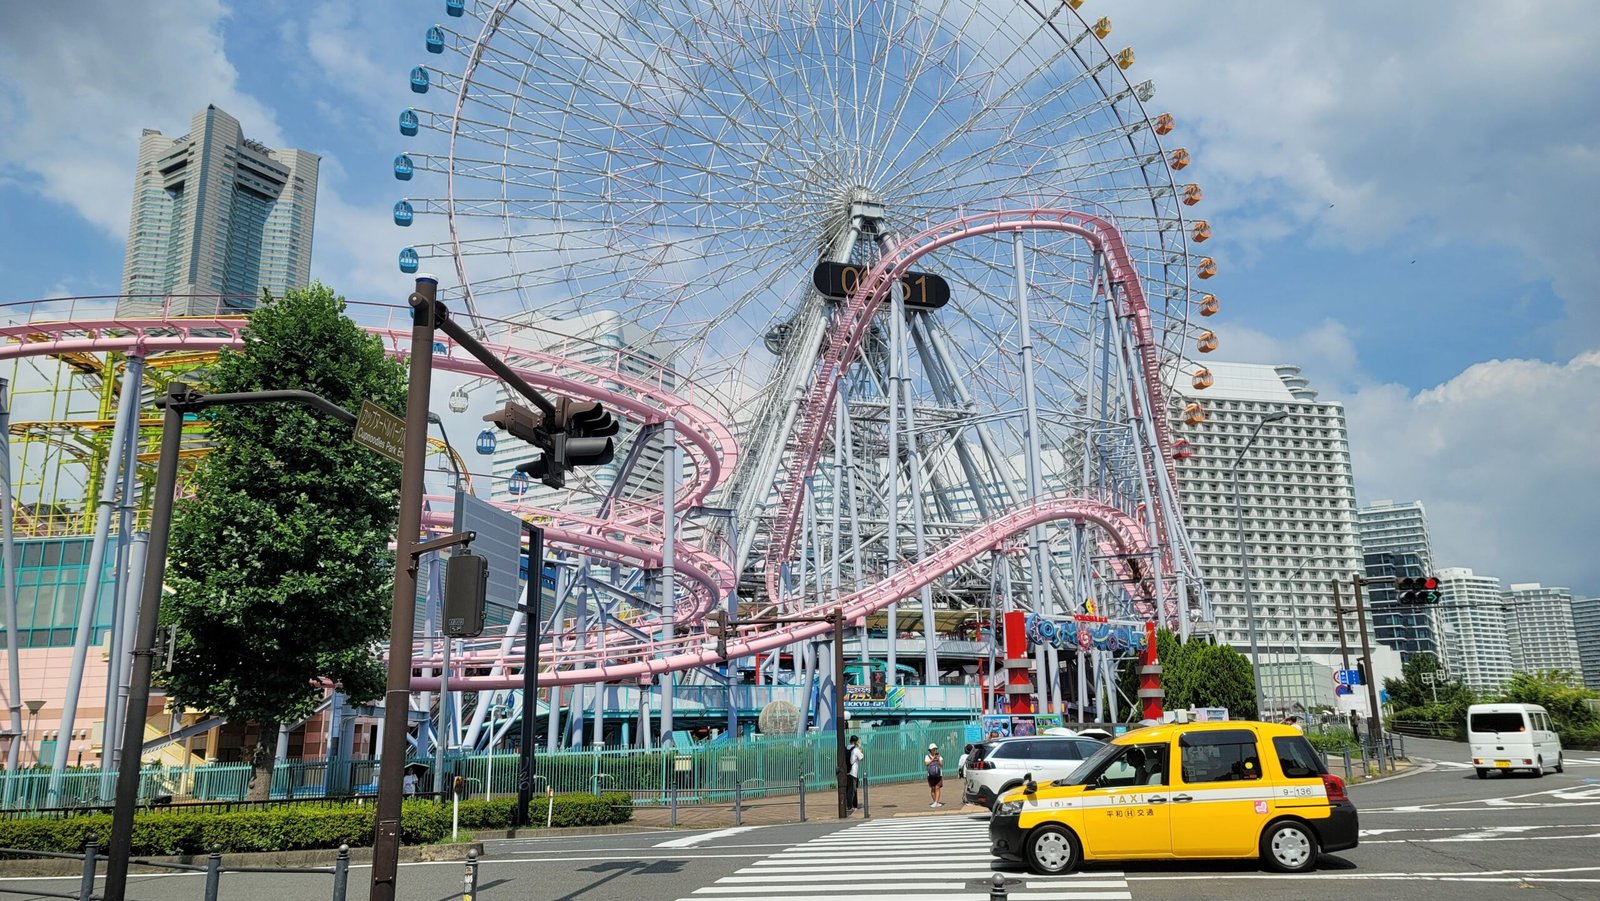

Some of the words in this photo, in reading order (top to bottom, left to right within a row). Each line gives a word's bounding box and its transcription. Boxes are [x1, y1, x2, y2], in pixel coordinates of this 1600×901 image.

[357, 427, 385, 449] Cupnoodles
[386, 441, 397, 455] Park
[1109, 794, 1144, 804] TAXI
